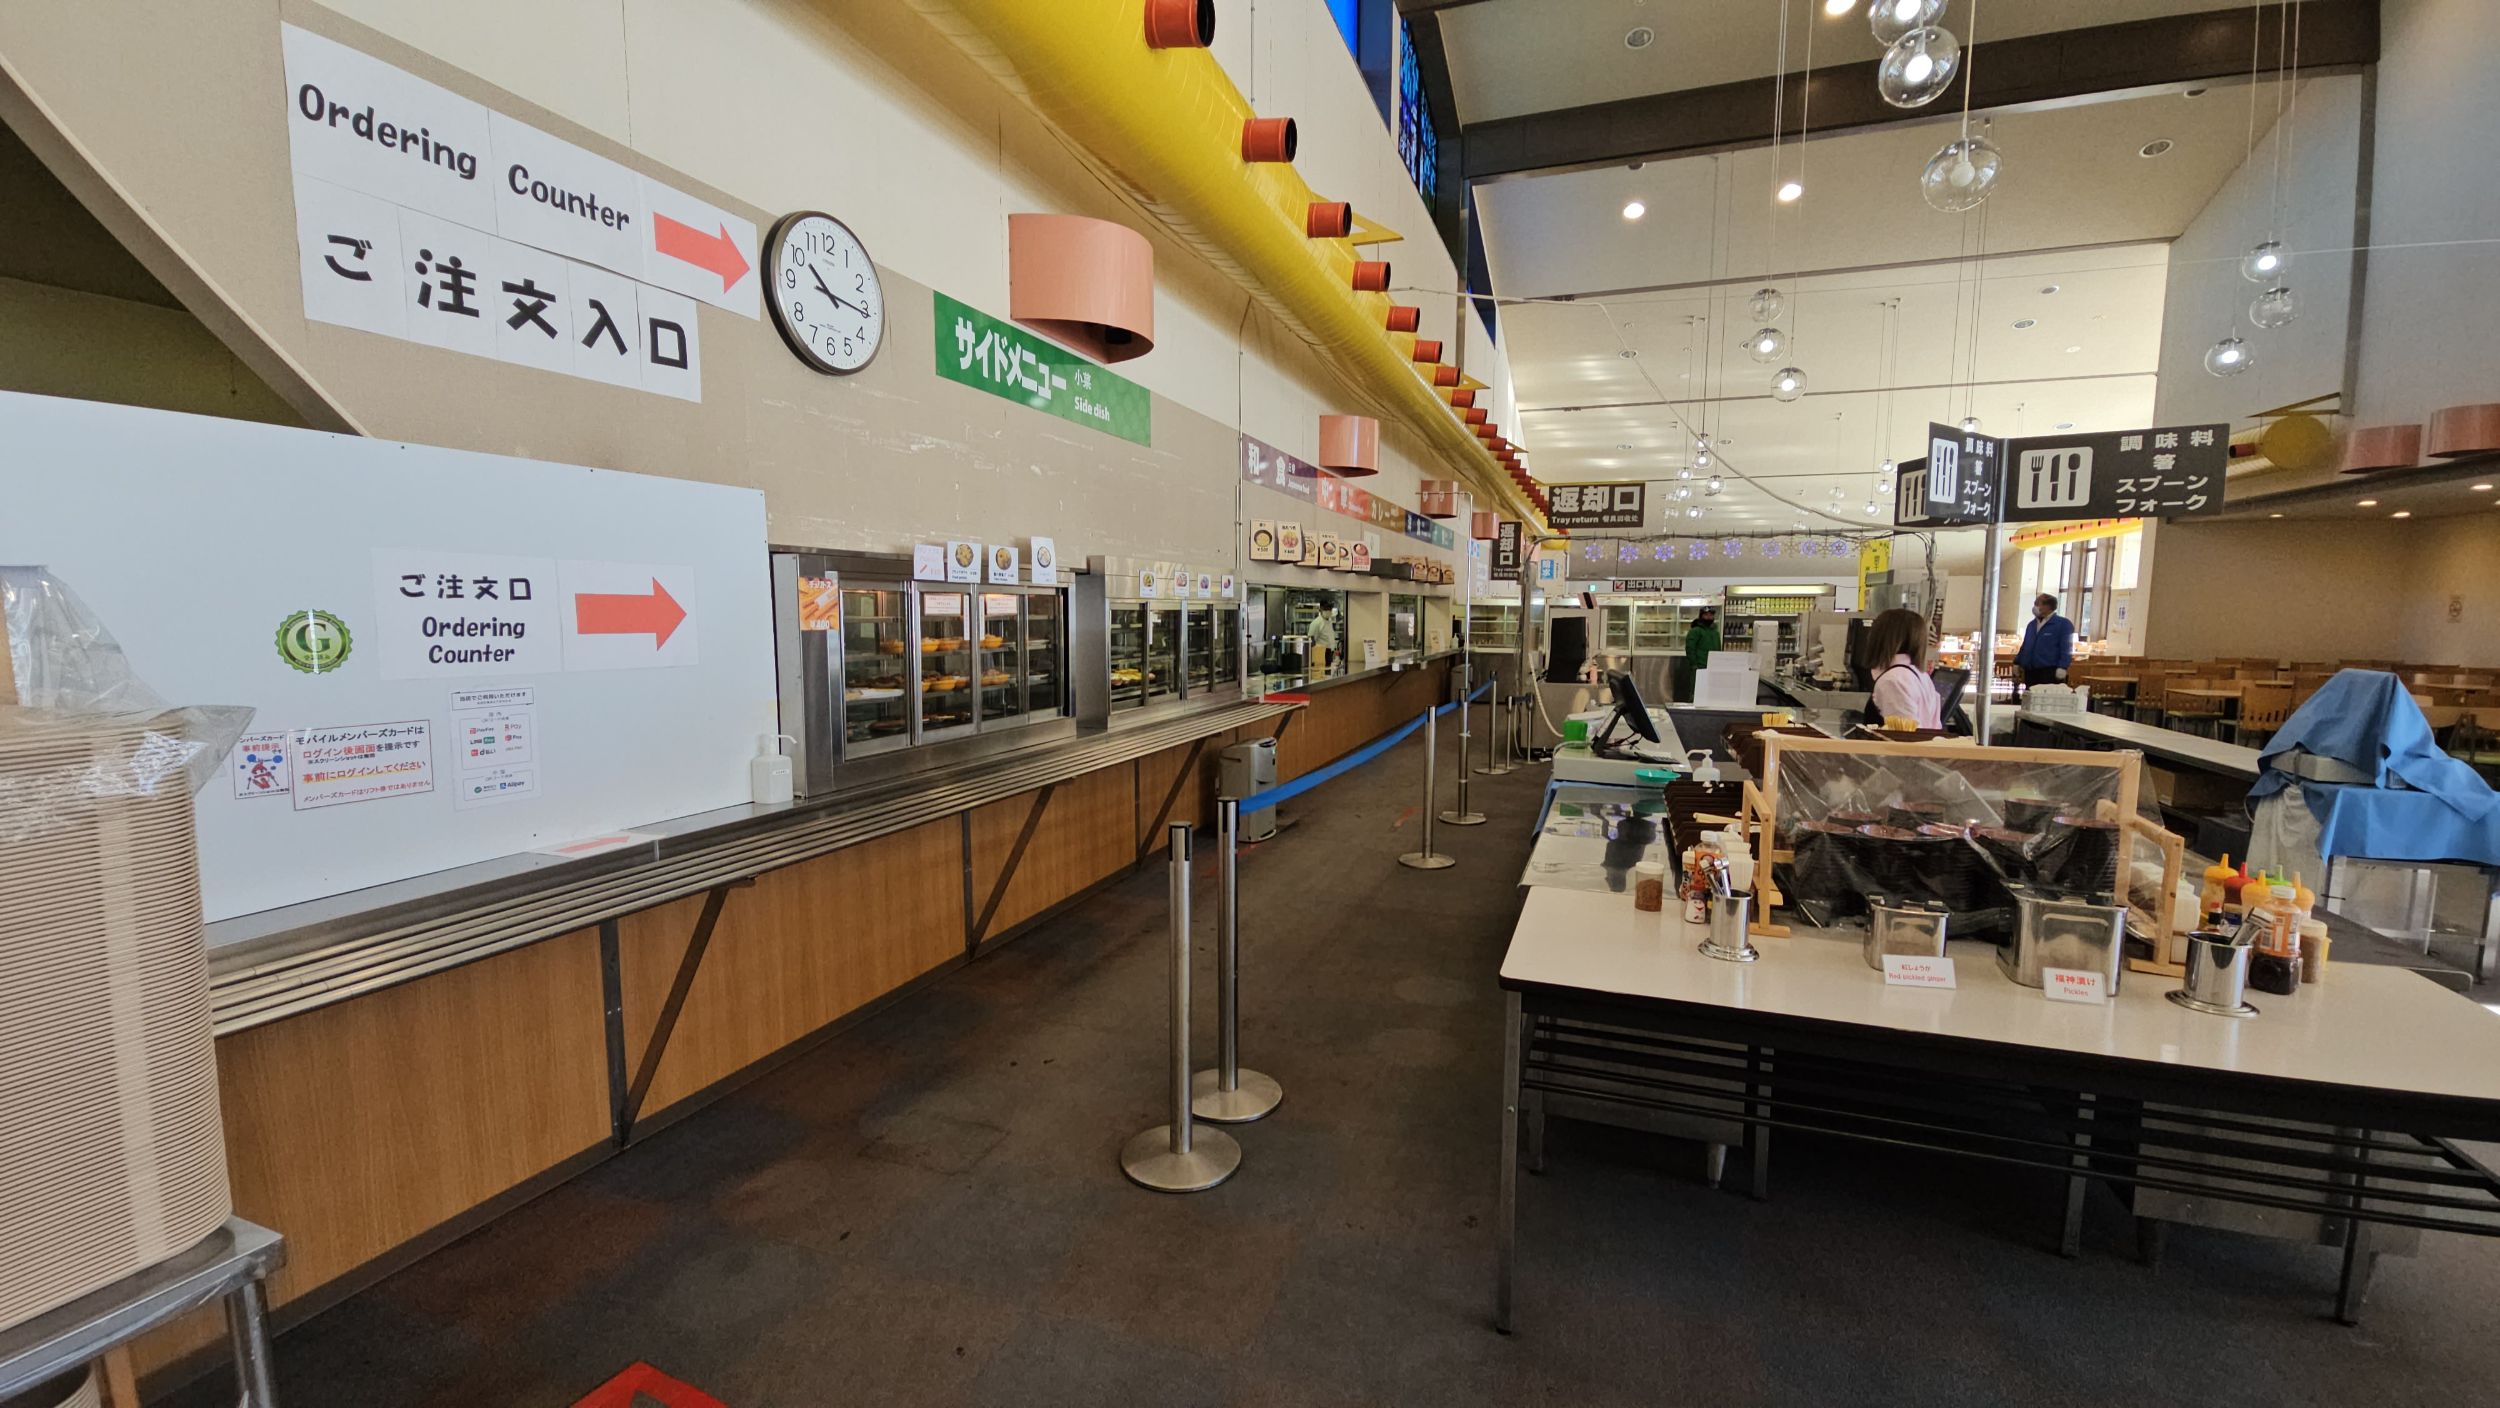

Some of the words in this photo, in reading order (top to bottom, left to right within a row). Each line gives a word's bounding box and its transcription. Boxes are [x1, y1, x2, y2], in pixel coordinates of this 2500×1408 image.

[299, 83, 477, 181] Ordering
[508, 163, 630, 232] Counter
[805, 231, 817, 254] 11
[821, 232, 835, 255] 12
[790, 244, 805, 267] 10
[785, 268, 796, 289] 9
[855, 273, 864, 293] 2
[324, 233, 688, 370] ご注文入口
[794, 301, 804, 322] 8
[860, 300, 870, 319] 3
[809, 324, 818, 344] 7
[855, 326, 865, 344] 4
[826, 337, 836, 356] 6
[843, 337, 853, 356] 5
[955, 316, 1067, 400] サイドメニュー
[1074, 396, 1093, 416] Side
[1094, 403, 1111, 422] dish
[1965, 436, 1994, 458] 調味料
[2119, 428, 2215, 452] 調味料
[2153, 453, 2177, 471] 箸
[1963, 480, 1992, 498] スプーン
[2116, 475, 2209, 494] スプーン
[1552, 486, 1641, 513] 返却口
[1963, 500, 1991, 517] フォーク
[2115, 493, 2208, 514] フォーク
[1552, 516, 1571, 525] Tray
[1499, 524, 1515, 566] 返却口
[399, 573, 533, 602] ご注文口
[421, 616, 525, 640] Ordering
[428, 644, 515, 664] Counter
[239, 734, 285, 743] ンバーズカード
[2063, 987, 2089, 996] Pickles
